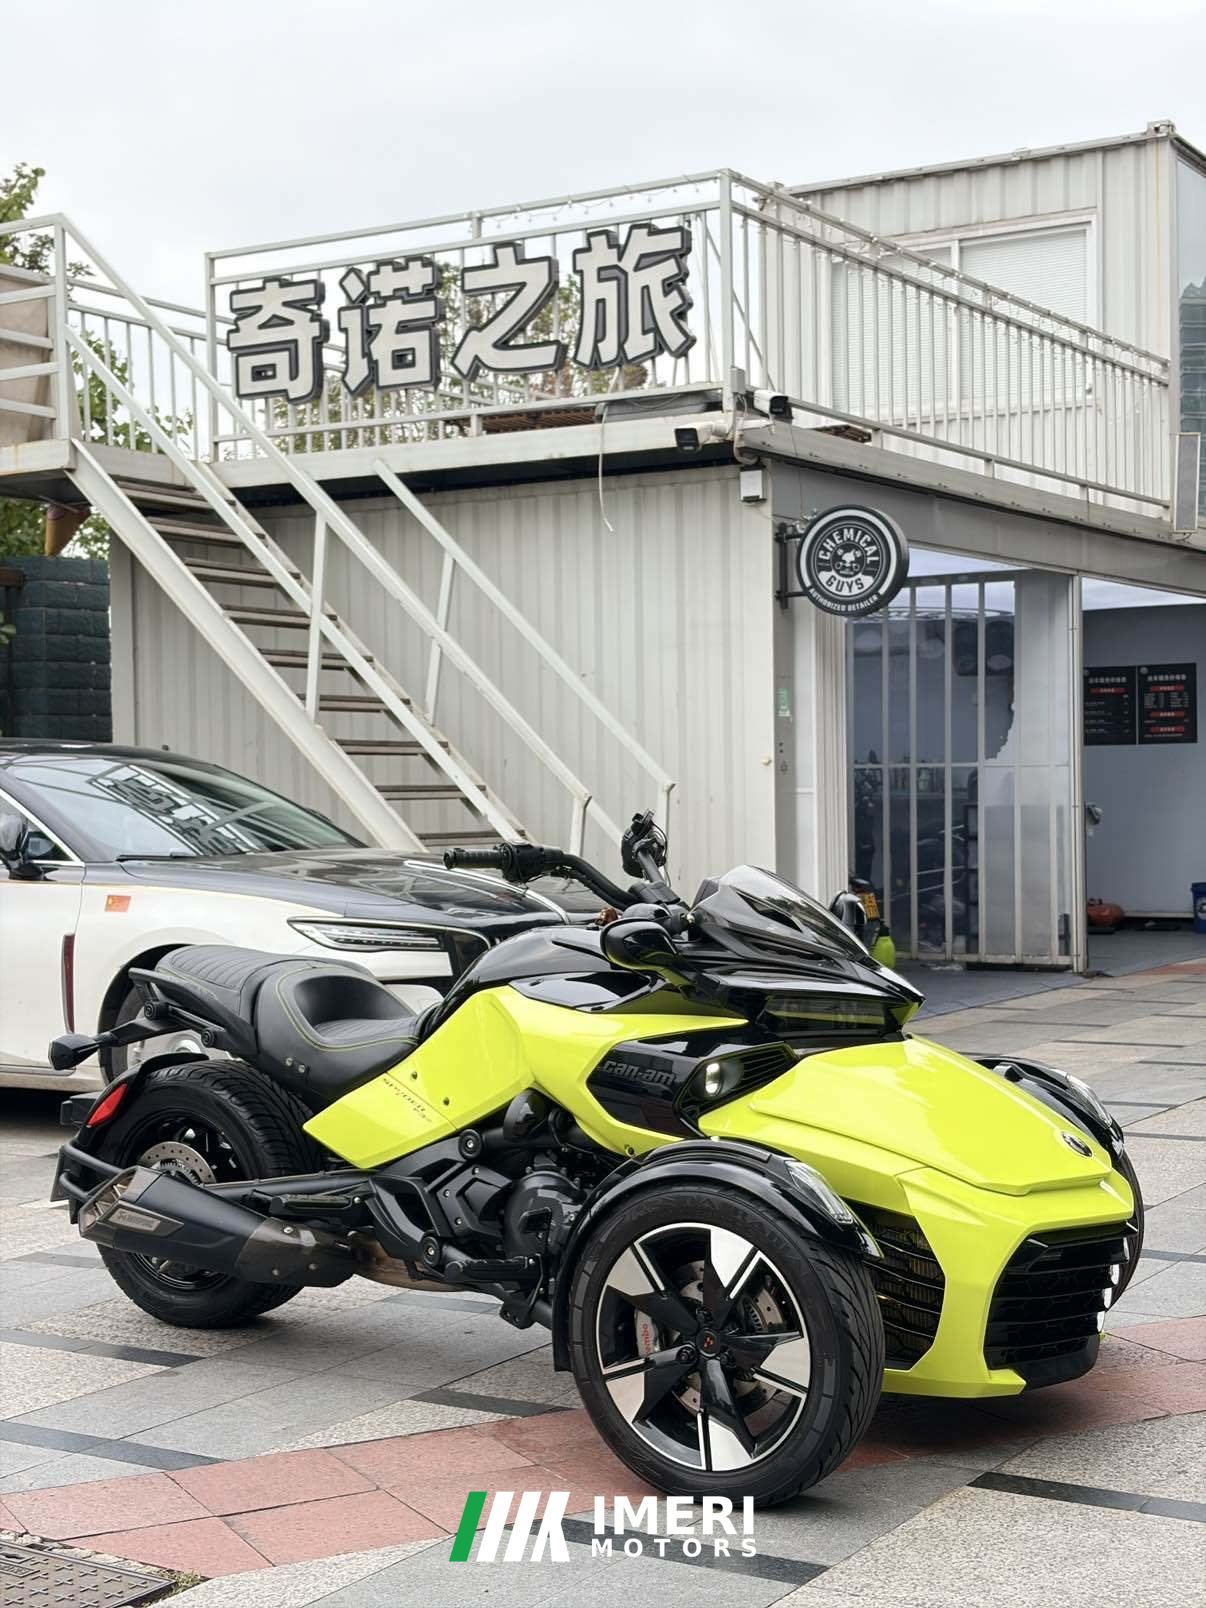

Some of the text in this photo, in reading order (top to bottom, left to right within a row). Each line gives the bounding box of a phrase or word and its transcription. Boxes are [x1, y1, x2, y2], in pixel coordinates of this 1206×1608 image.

[227, 222, 698, 402] 奇诺之旅
[818, 527, 880, 564] CHEMICAL
[809, 587, 879, 612] AUTHORIZED DETAILER
[825, 575, 865, 593] GUYS
[642, 1323, 651, 1354] embo
